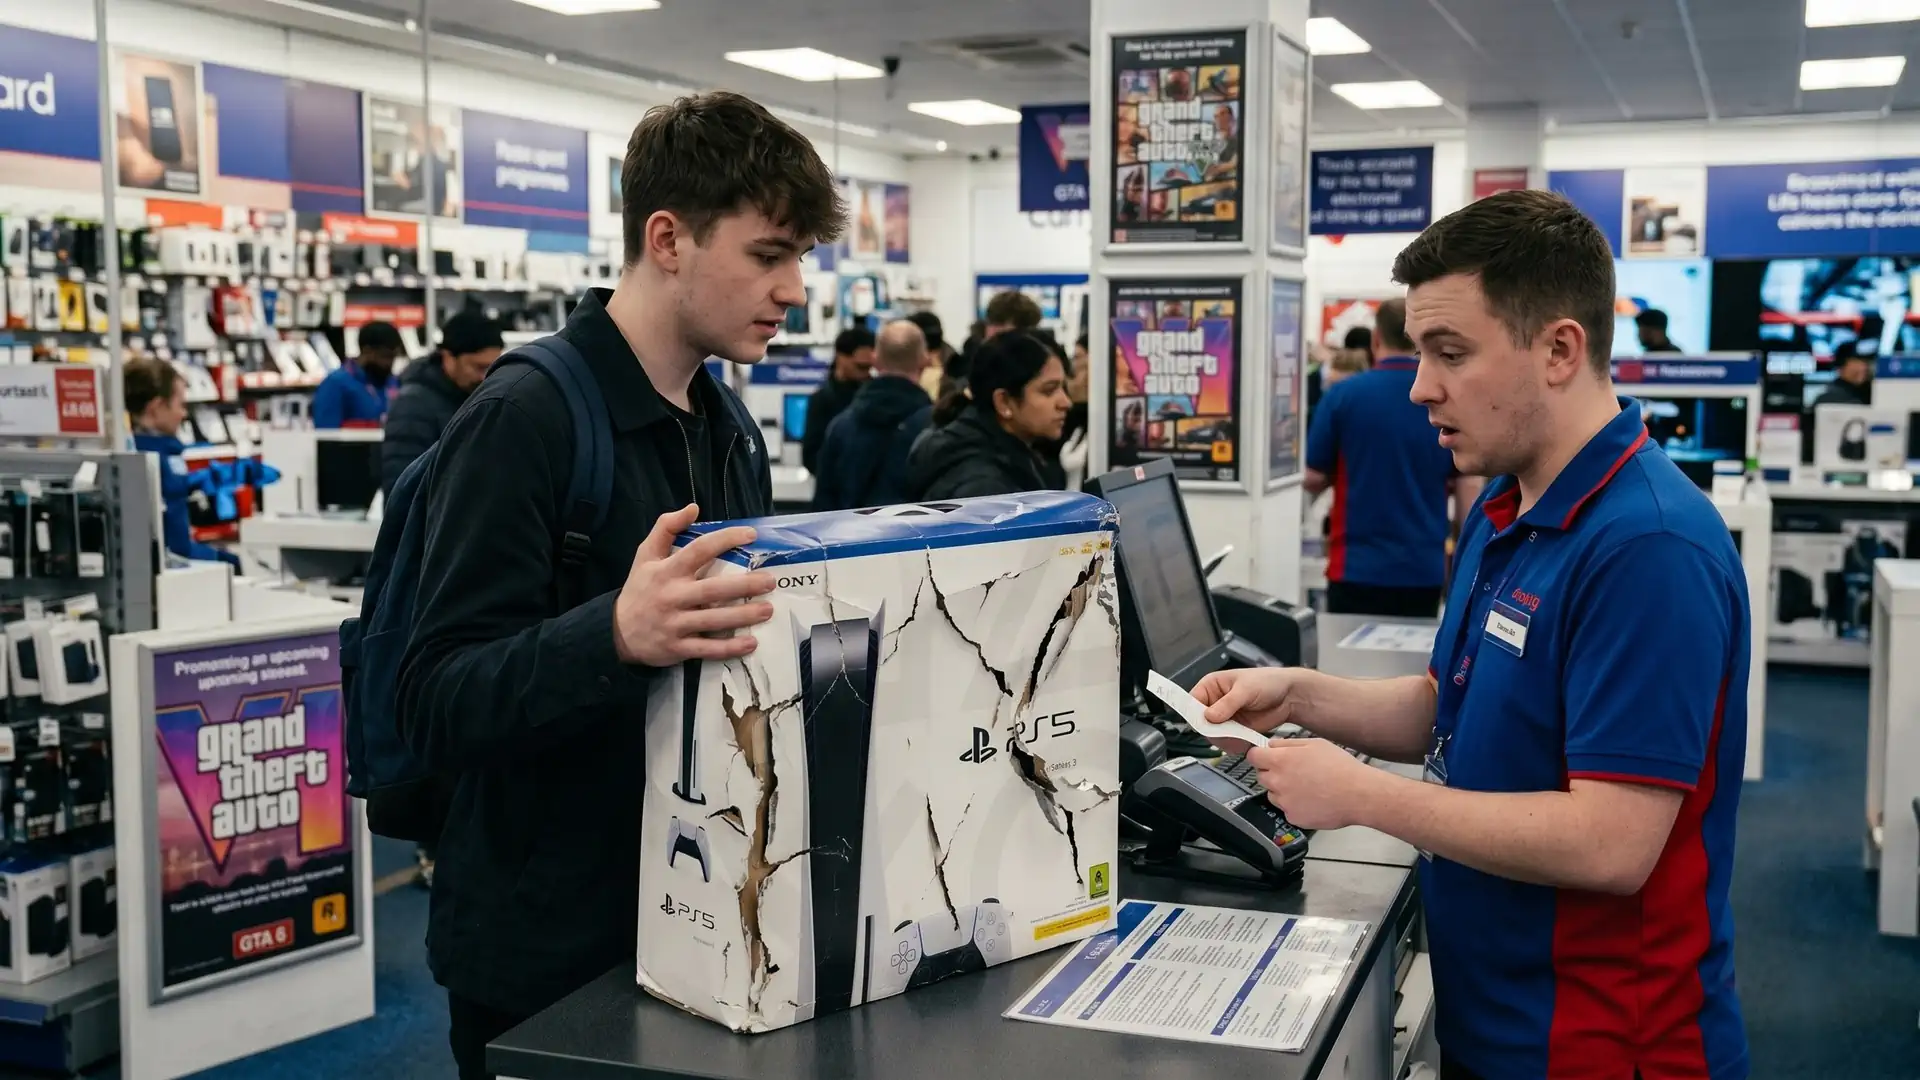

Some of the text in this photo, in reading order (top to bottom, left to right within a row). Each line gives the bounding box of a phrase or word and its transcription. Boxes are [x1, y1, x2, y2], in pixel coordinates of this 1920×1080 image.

[1138, 97, 1201, 125] grand
[1150, 121, 1214, 142] theft
[1136, 327, 1205, 357] grand
[1149, 354, 1218, 376] theft
[1145, 375, 1200, 395] auto
[778, 575, 818, 588] ONY
[198, 705, 305, 772] grand
[1006, 710, 1075, 752] PS5
[220, 750, 328, 800] theft
[212, 791, 300, 839] auto
[678, 902, 715, 930] PS5
[239, 926, 287, 952] GTA 6
